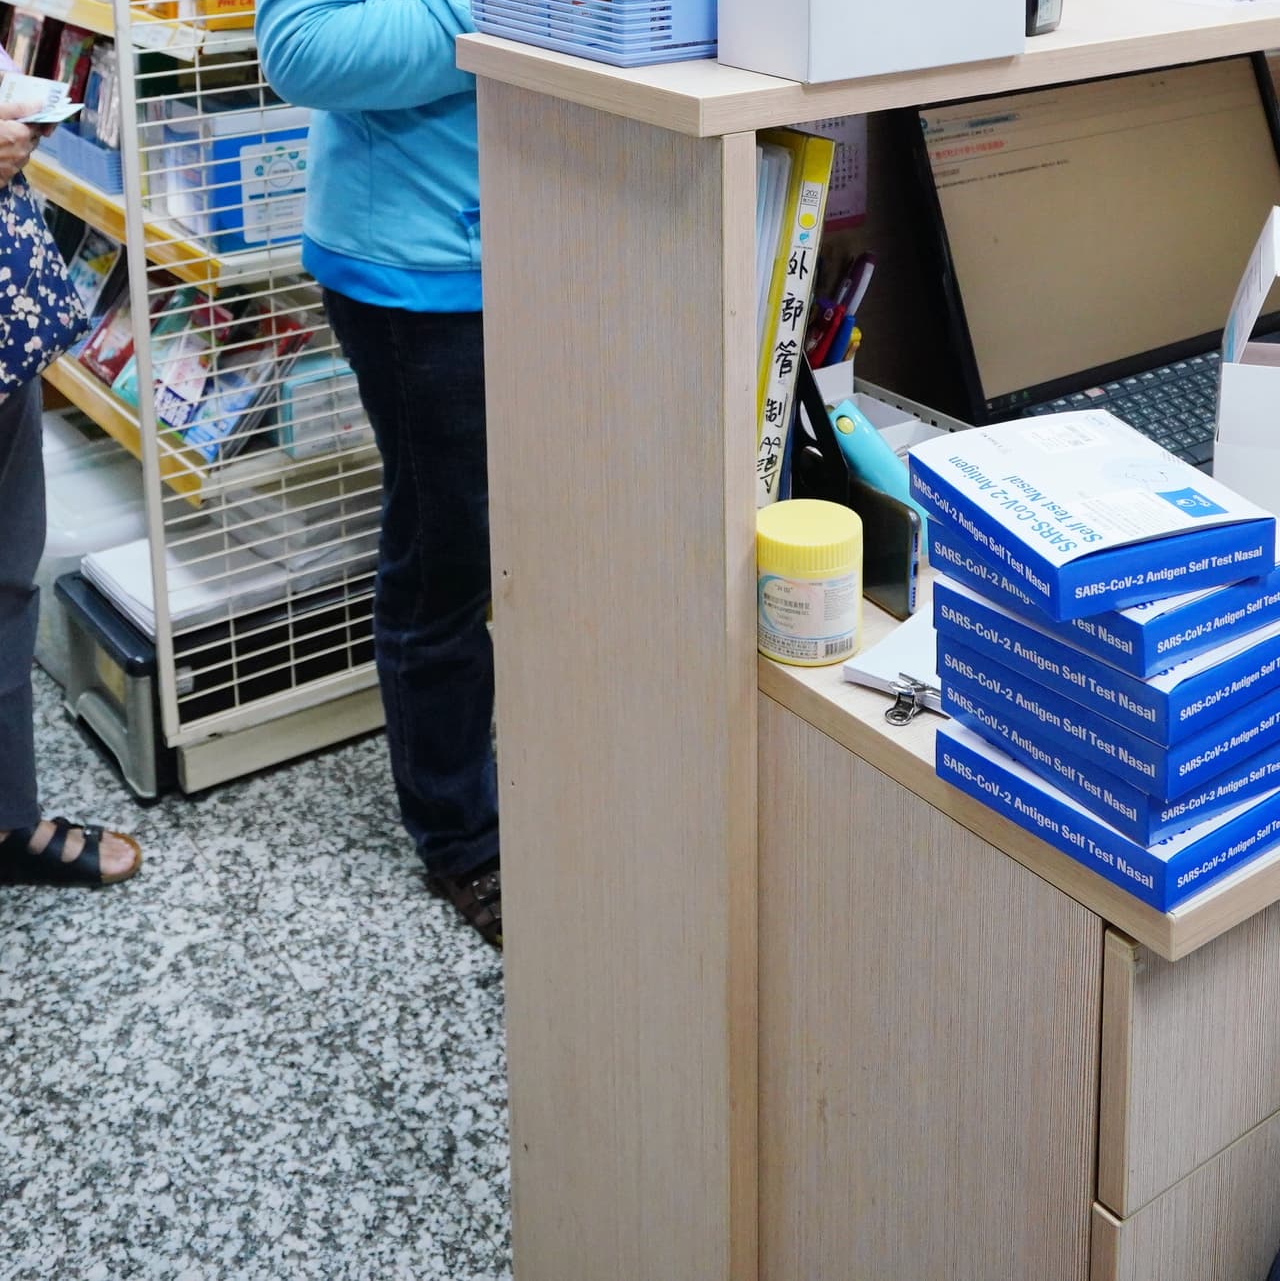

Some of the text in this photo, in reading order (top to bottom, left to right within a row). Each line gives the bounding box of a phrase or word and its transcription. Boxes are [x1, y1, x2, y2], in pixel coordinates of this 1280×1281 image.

[912, 474, 1051, 598] SARS-CoV-2 Antigen Self Test Nasal
[948, 455, 1078, 553] SARS-CoV-2 Antigen
[1002, 475, 1104, 544] Self Test Nasal
[934, 541, 999, 586] SARS-CoV-2
[1098, 623, 1133, 655] Nasal
[1075, 546, 1263, 599] SARS-CoV-2 Antigen Self Test Nasal
[1157, 621, 1212, 654] SARS-CoV-2
[1213, 609, 1245, 630] Antigen
[1246, 597, 1263, 615] Self
[1263, 590, 1280, 606] Test
[941, 605, 1156, 723] SARS-CoV-2 Antigen Self Test Nasal
[1180, 688, 1230, 721] SARS-CoV-2
[1231, 672, 1260, 696] Antigen
[1261, 660, 1275, 679] Self
[944, 654, 1155, 778] SARS-CoV-2 Antigen Self Test Nasal
[947, 687, 1137, 822] SARS-CoV-2 Antigen Self Test Nasal
[1179, 741, 1229, 777] SARS-CoV-2
[1230, 725, 1259, 748] Antigen
[1260, 713, 1274, 731] Self
[943, 753, 1154, 890] SARS-CoV-2 Antigen Self Test Nasal
[1161, 790, 1216, 823] SARS-CoV-2
[1217, 776, 1248, 798] Antigen
[1249, 764, 1265, 782] Self
[1177, 852, 1226, 888] SARS-CoV-2
[1228, 833, 1256, 858] Antigen
[1256, 821, 1271, 840] Self
